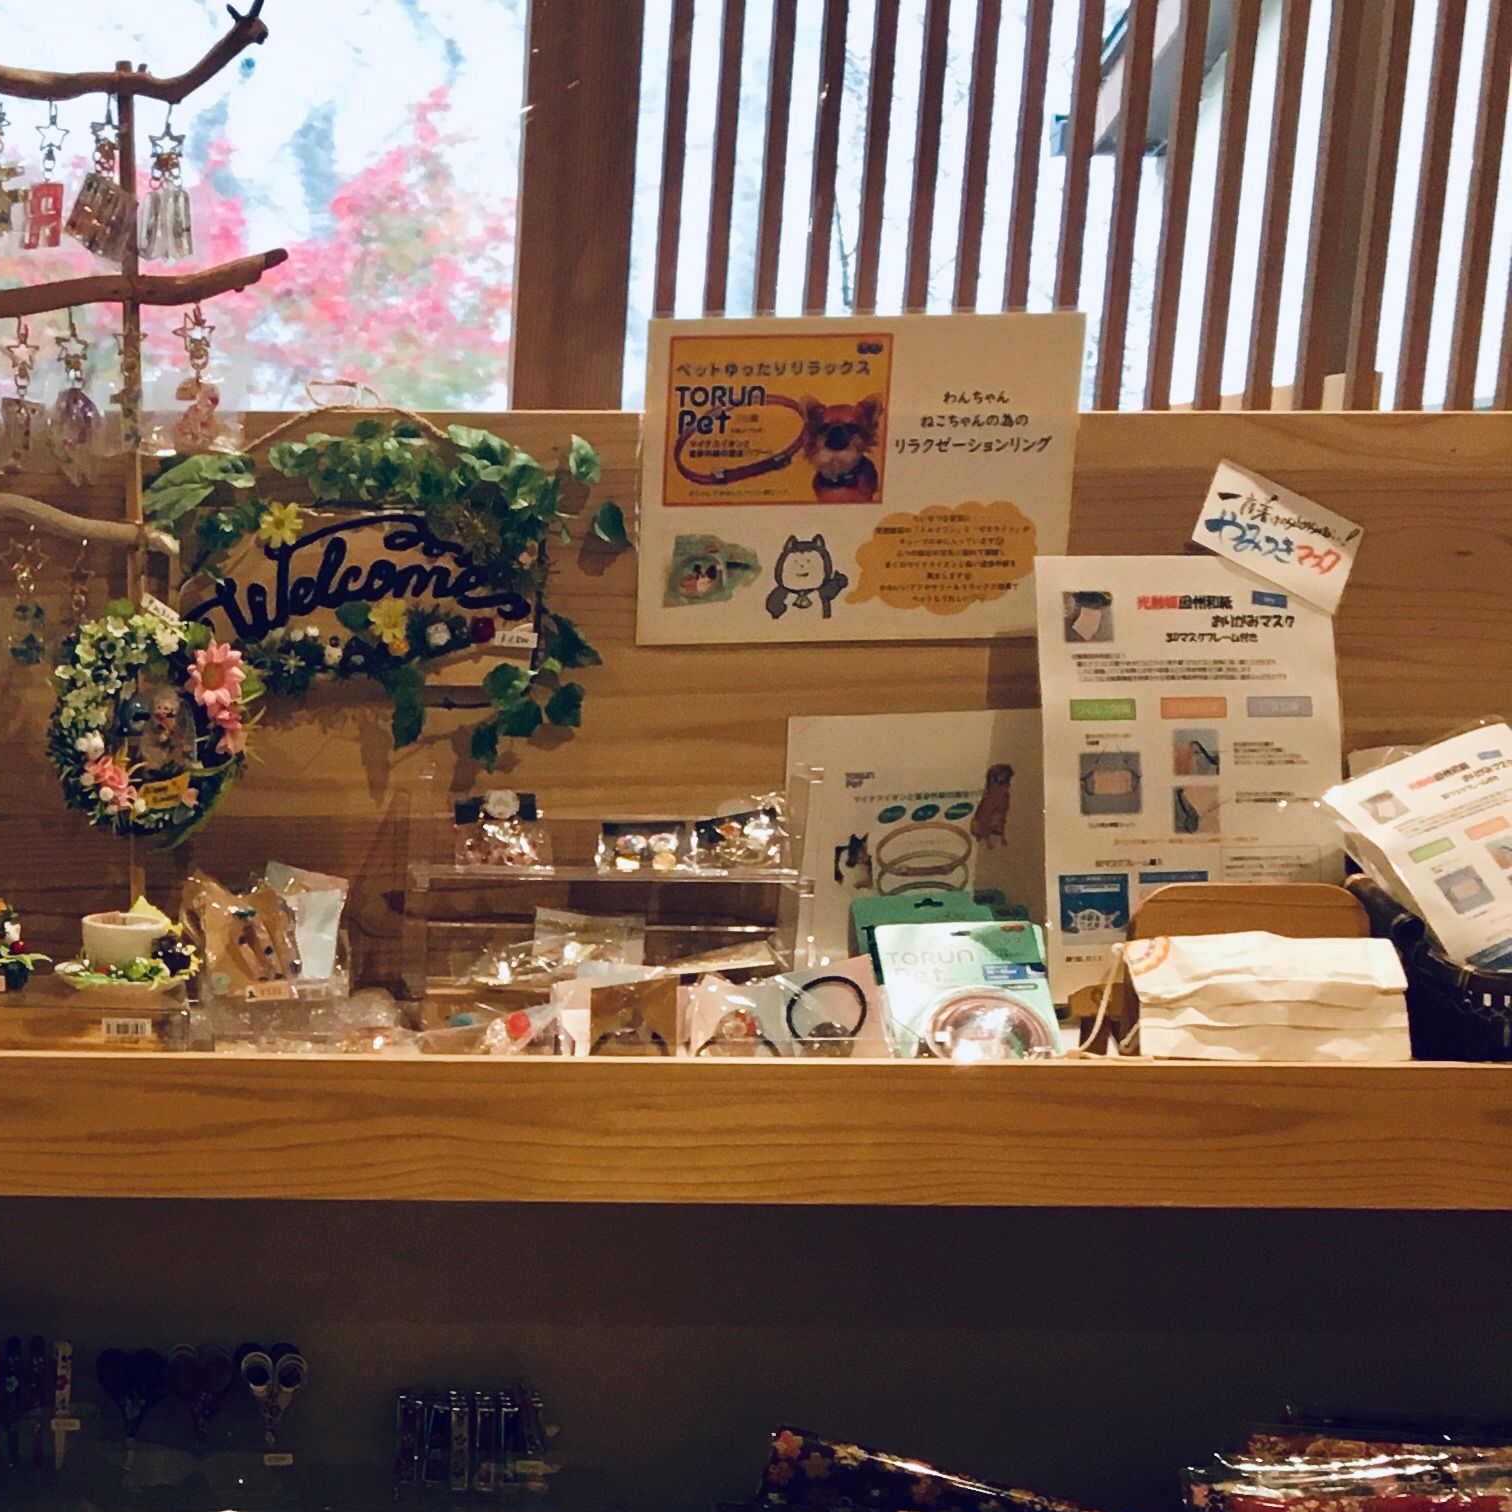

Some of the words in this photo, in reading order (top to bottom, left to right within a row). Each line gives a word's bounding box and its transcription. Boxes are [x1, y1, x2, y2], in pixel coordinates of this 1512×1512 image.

[676, 360, 871, 377] ペットゆったりリラックス
[675, 386, 766, 408] TORUN
[943, 390, 1009, 405] わんちゃん
[678, 409, 731, 436] Pet
[920, 414, 1029, 428] ねこちゃんの為の
[894, 435, 1053, 454] リラクゼーションリング
[181, 514, 531, 640] Welcome
